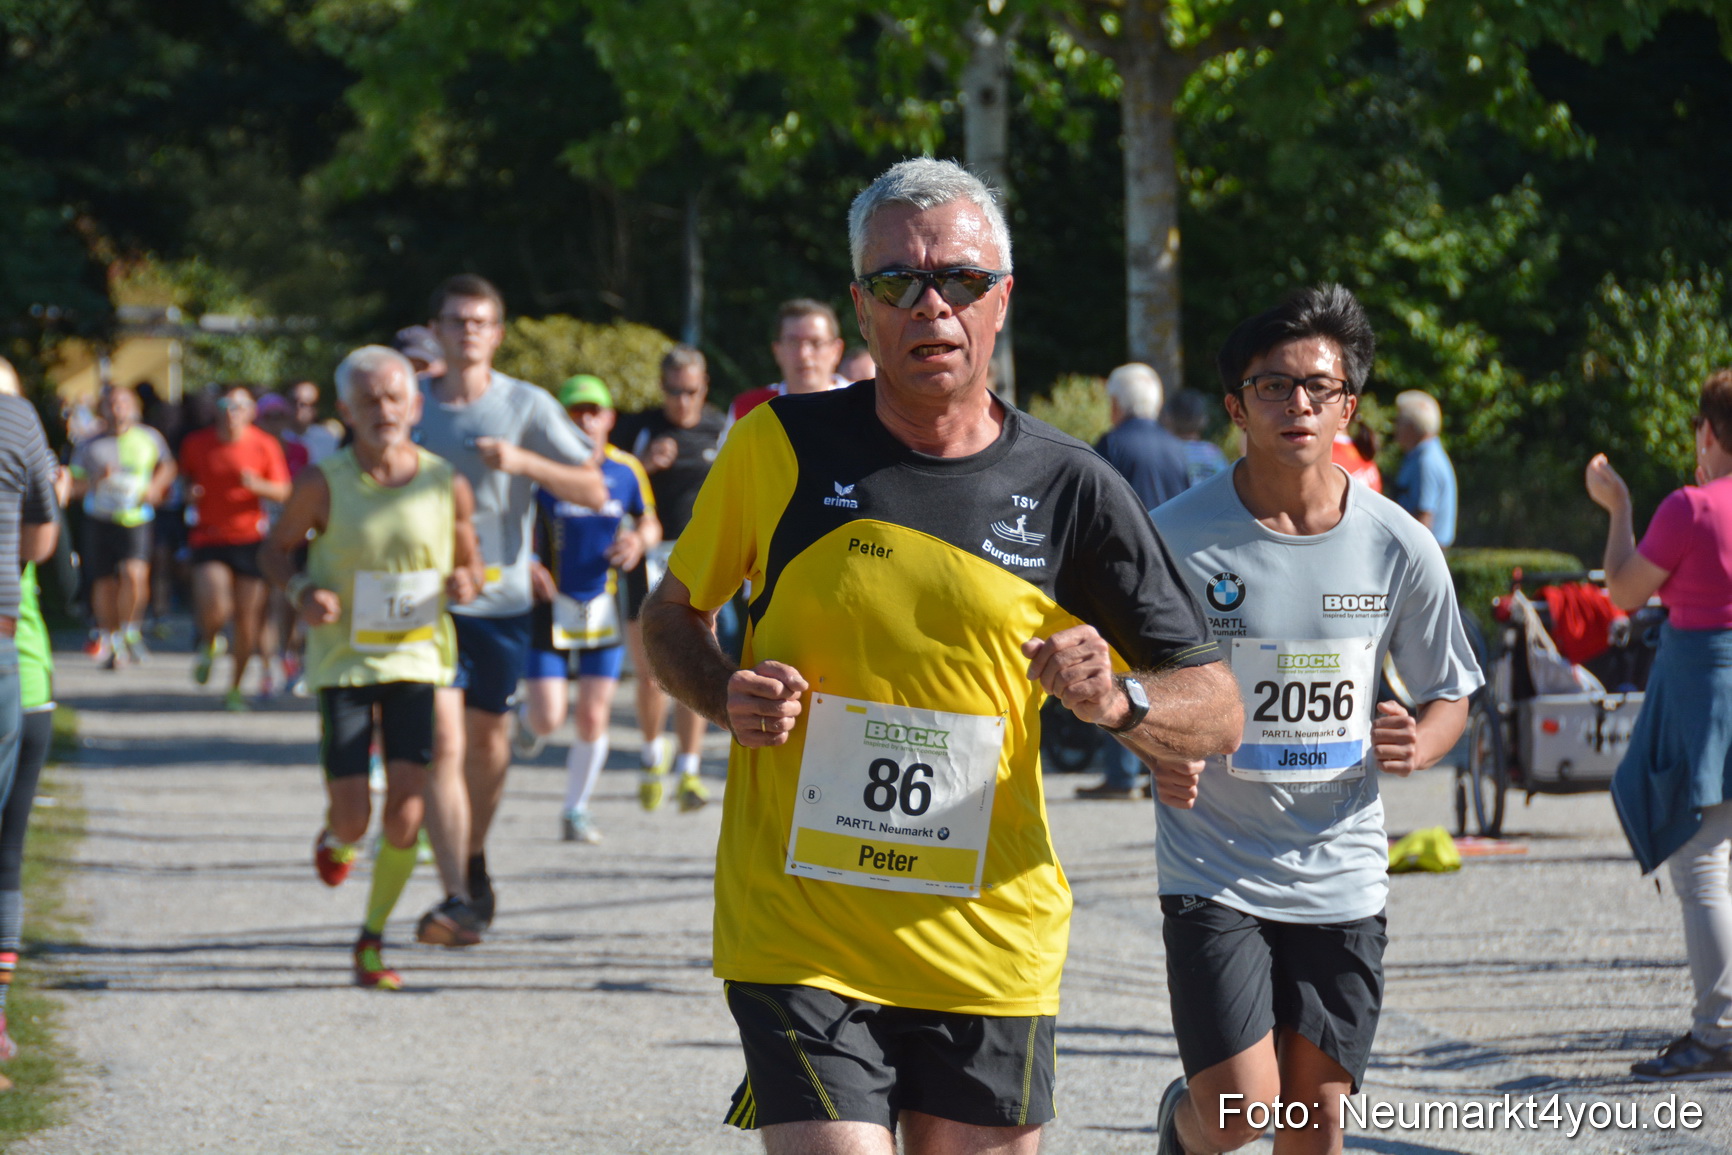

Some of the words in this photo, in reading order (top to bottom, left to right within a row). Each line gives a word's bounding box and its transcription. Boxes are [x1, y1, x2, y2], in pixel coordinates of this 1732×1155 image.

[823, 496, 858, 509] erima
[1011, 495, 1039, 510] TSV
[848, 538, 893, 559] Peter
[982, 538, 1046, 567] Burgthann
[1209, 573, 1244, 586] BMW
[1323, 594, 1390, 611] BOCK
[1212, 628, 1247, 636] umarkt
[1277, 654, 1341, 668] BOCK
[1253, 680, 1355, 723] 2056
[866, 720, 950, 748] BOCK
[1262, 729, 1293, 738] PARTL
[1295, 729, 1334, 738] Neumarkt
[863, 738, 890, 749] inspired
[891, 743, 899, 752] by
[1278, 749, 1327, 766] Jason
[808, 790, 816, 799] B
[863, 758, 934, 817] 86
[836, 815, 876, 832] PARTL
[879, 822, 933, 838] Neumarkt
[858, 845, 918, 872] Peter
